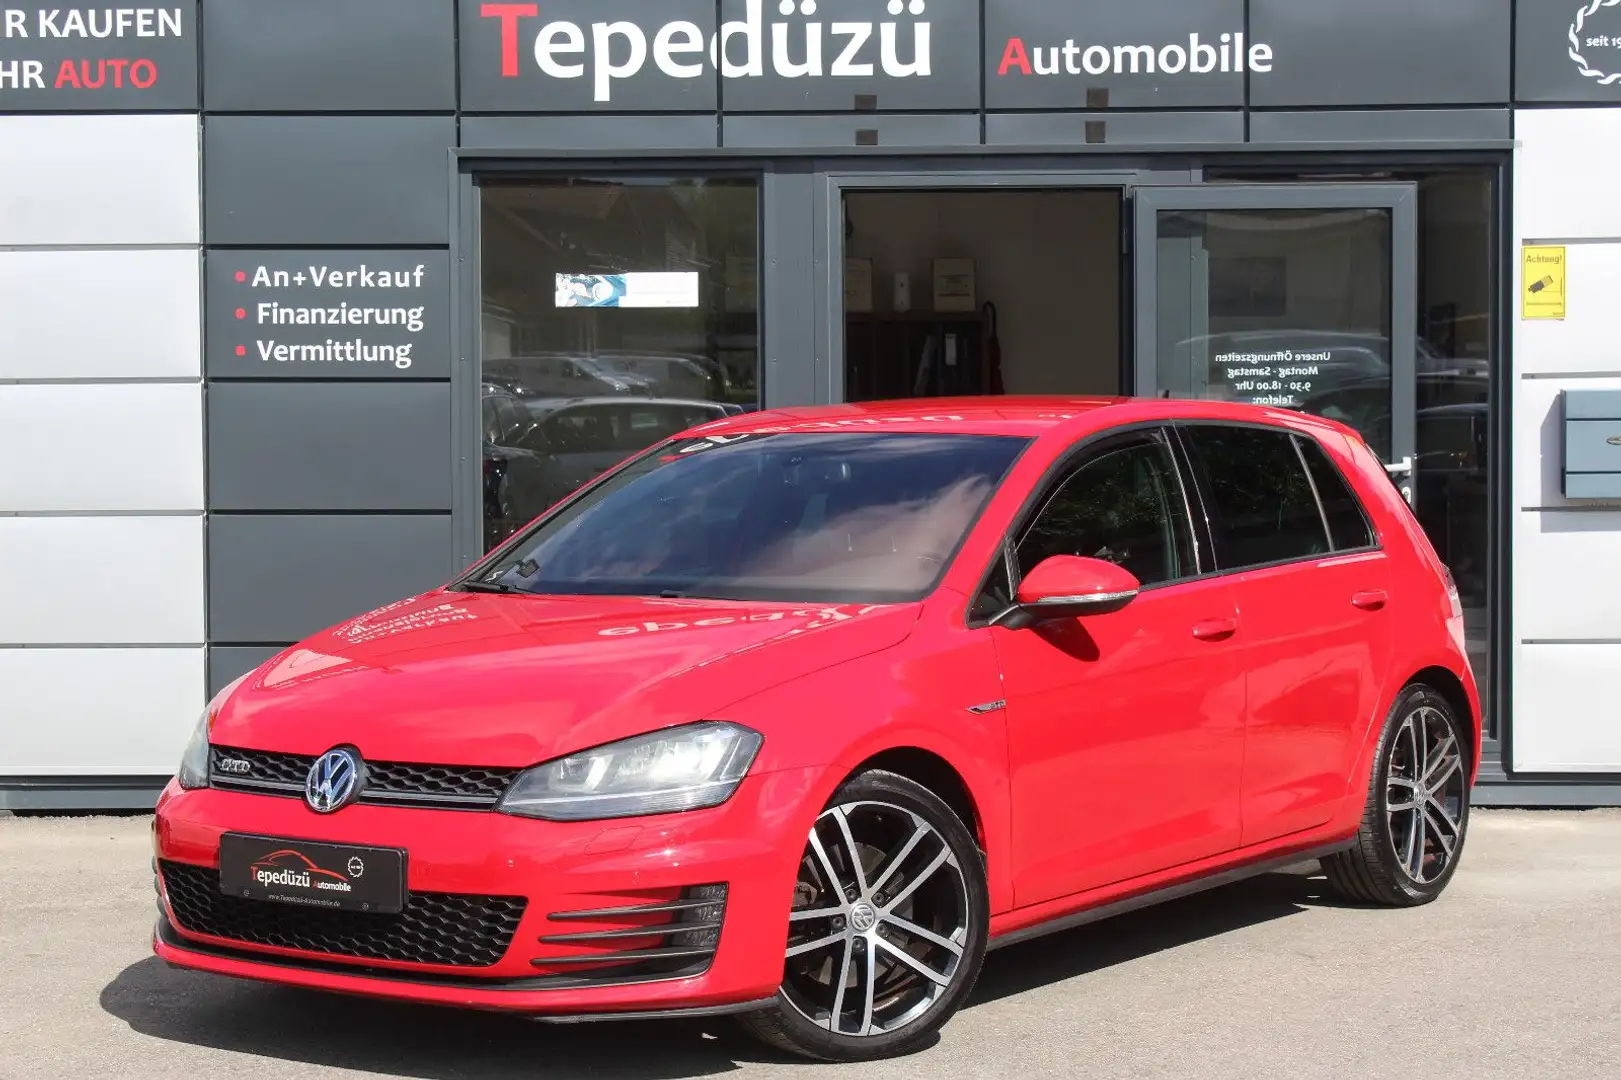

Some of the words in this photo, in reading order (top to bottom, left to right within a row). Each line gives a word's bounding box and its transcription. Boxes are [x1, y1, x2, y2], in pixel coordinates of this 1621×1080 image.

[38, 8, 182, 38] KAUFEN
[480, 0, 932, 102] Tepedüzü
[997, 32, 1273, 76] Automobile
[1586, 34, 1609, 47] seit
[54, 58, 157, 89] AUTO
[1526, 253, 1562, 265] Achtung!
[251, 264, 425, 288] An+Verkauf
[257, 301, 425, 332] Finanzierung
[256, 338, 413, 369] Vermittlung
[250, 866, 310, 888] Tepedüzü
[312, 880, 352, 892] Automobile
